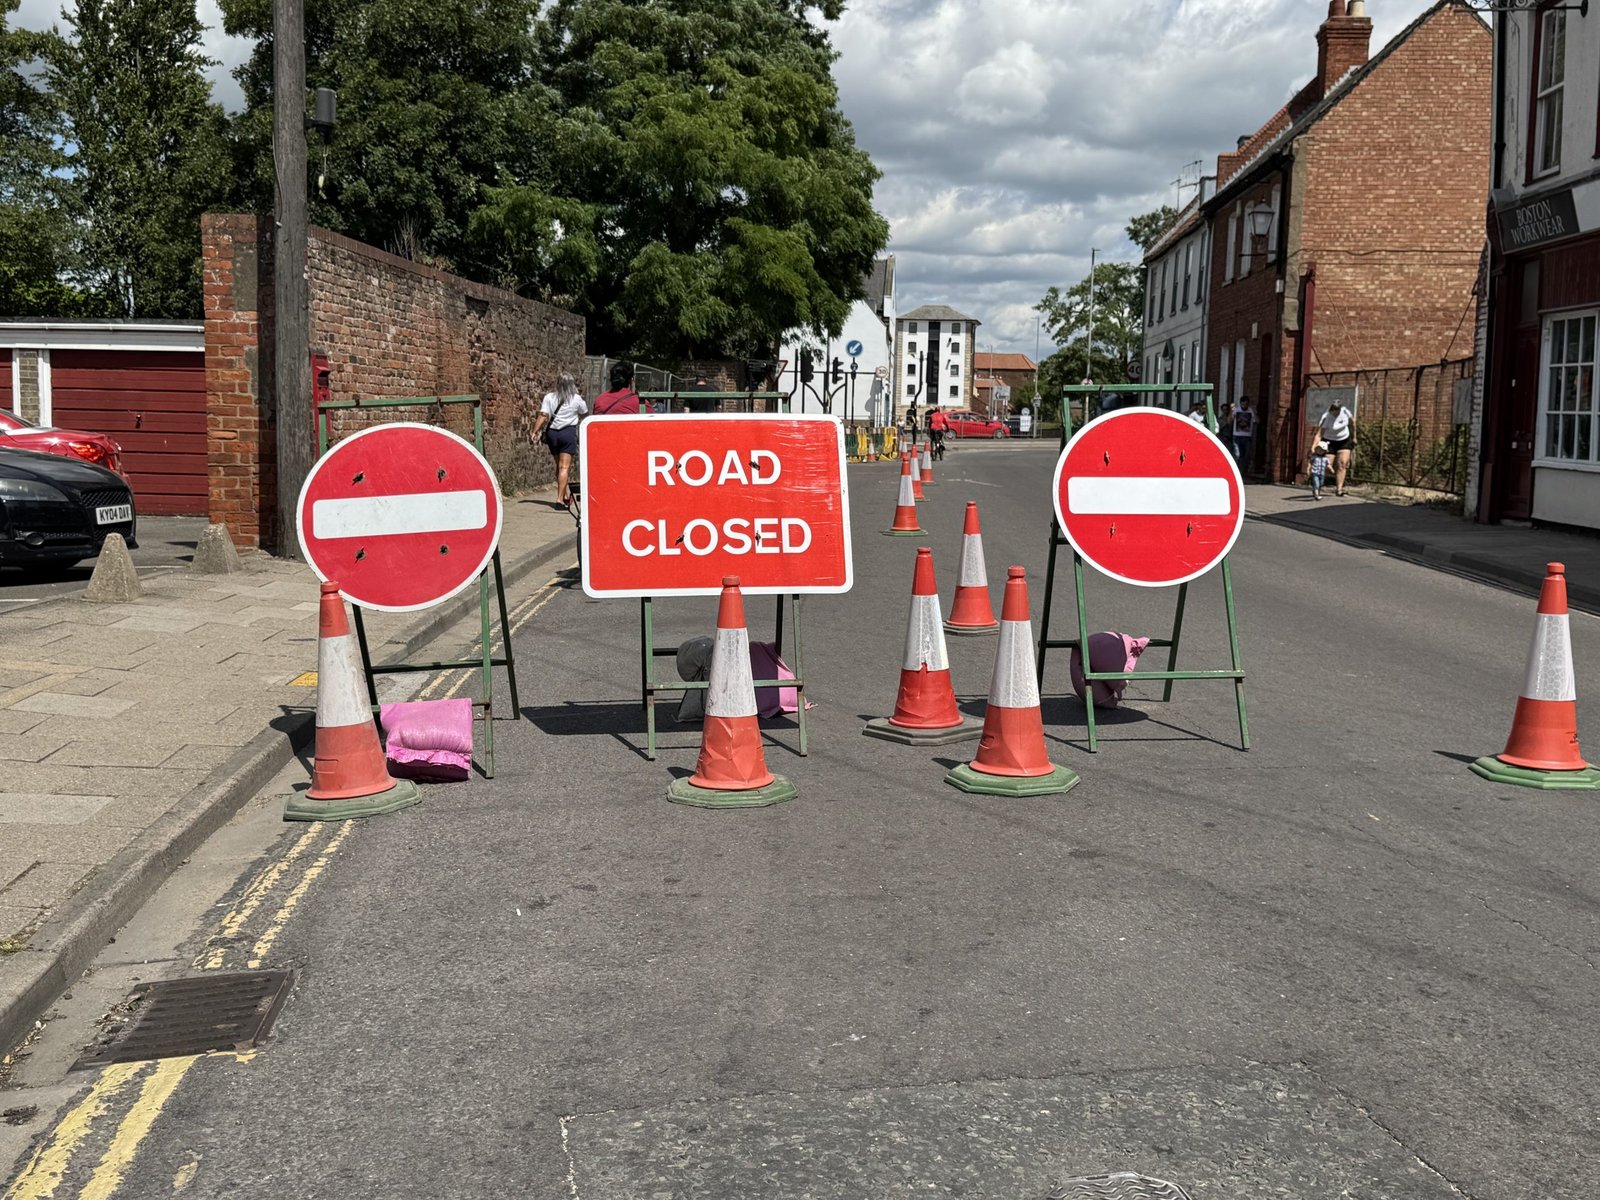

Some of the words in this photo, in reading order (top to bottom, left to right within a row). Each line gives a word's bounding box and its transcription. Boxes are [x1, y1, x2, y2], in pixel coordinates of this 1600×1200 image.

[1510, 215, 1565, 244] WORKWEAR
[1516, 200, 1552, 226] BOSTON
[647, 450, 782, 487] ROAD
[621, 518, 812, 557] CLOSED
